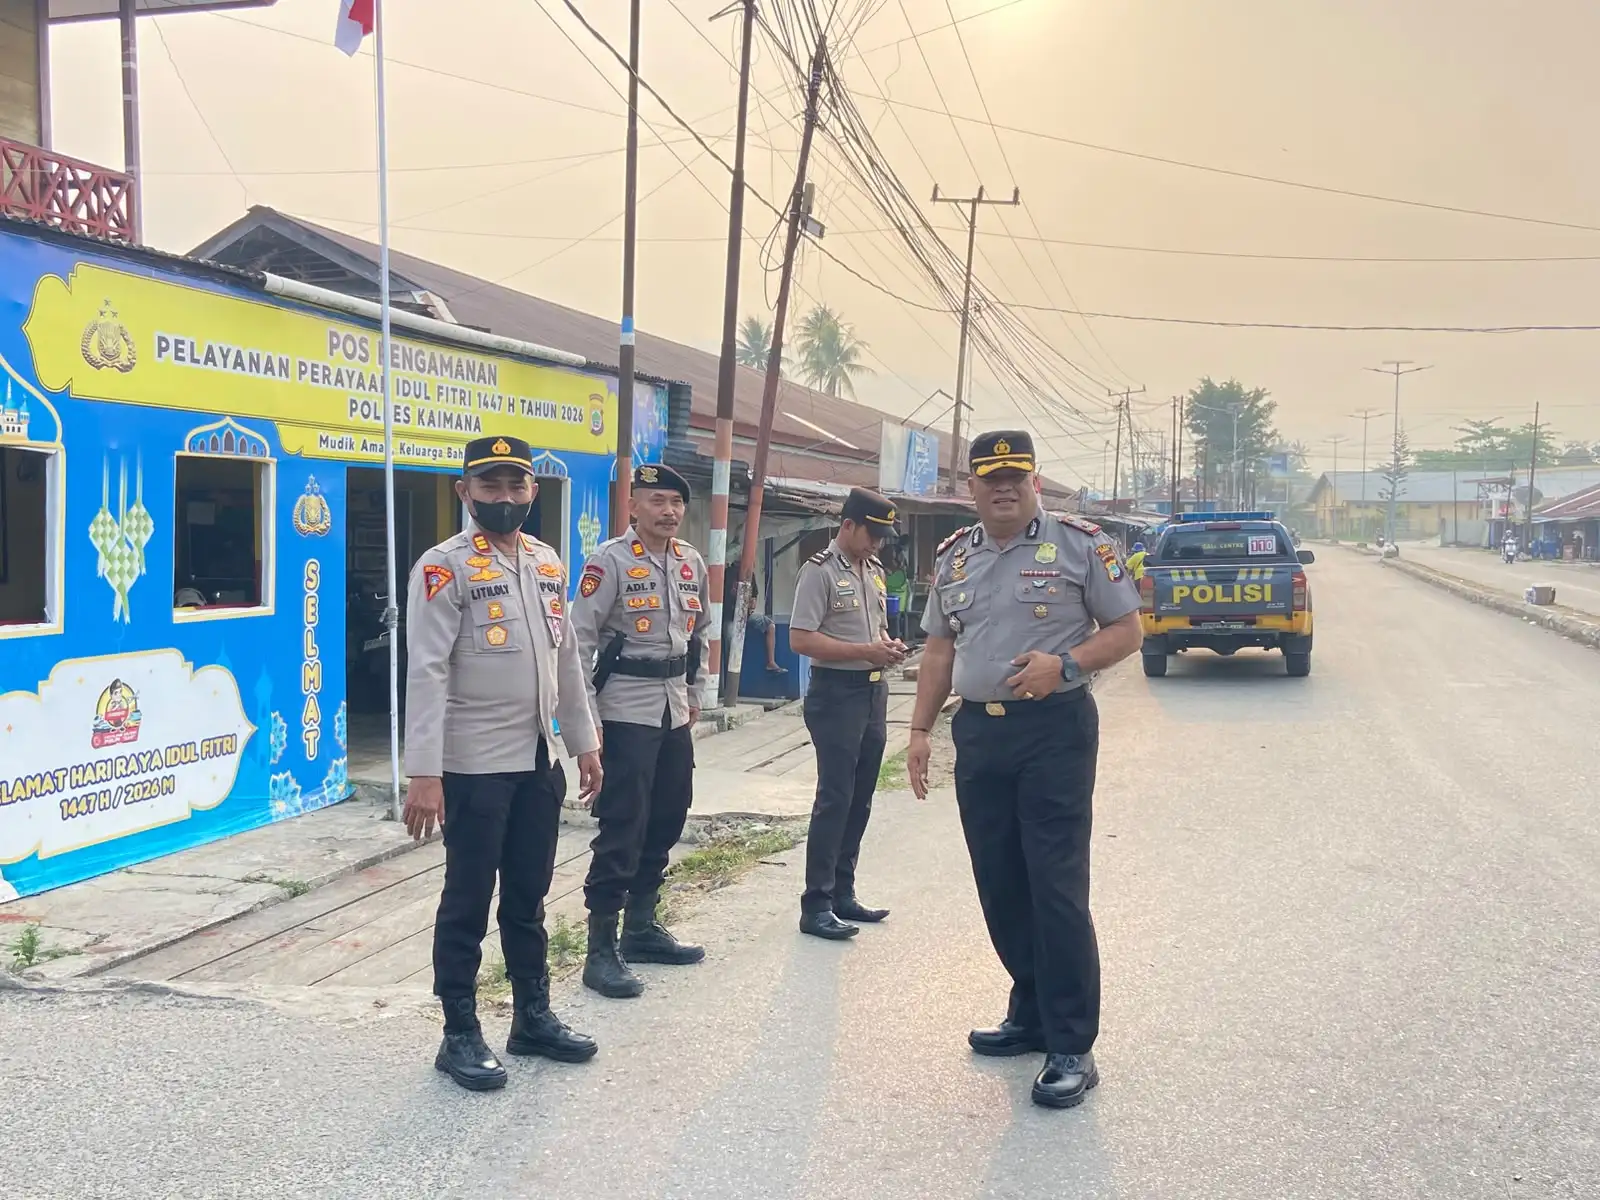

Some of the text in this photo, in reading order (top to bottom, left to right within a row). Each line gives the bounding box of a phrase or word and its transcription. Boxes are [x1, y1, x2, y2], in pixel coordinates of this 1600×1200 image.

[328, 329, 370, 363] POS
[156, 335, 290, 379] PELAYANAN
[396, 378, 431, 401] IDUL
[436, 384, 472, 407] FITRI
[477, 391, 503, 412] 1447
[507, 398, 516, 414] H
[520, 399, 557, 419] TAHUN
[561, 406, 584, 423] 2026
[349, 398, 482, 433] POLES KAIMANA
[319, 434, 355, 451] Mudik
[361, 439, 395, 456] Ama,
[400, 442, 443, 460] Keluarga
[1251, 540, 1274, 553] 110
[1173, 584, 1272, 604] POLISI
[303, 560, 321, 759] SELMAT
[0, 733, 238, 806] LAMAT HARI RAYA IDUL FITRI
[60, 790, 98, 821] 1447
[98, 790, 112, 811] H
[124, 779, 160, 806] 2026
[161, 774, 176, 796] M
